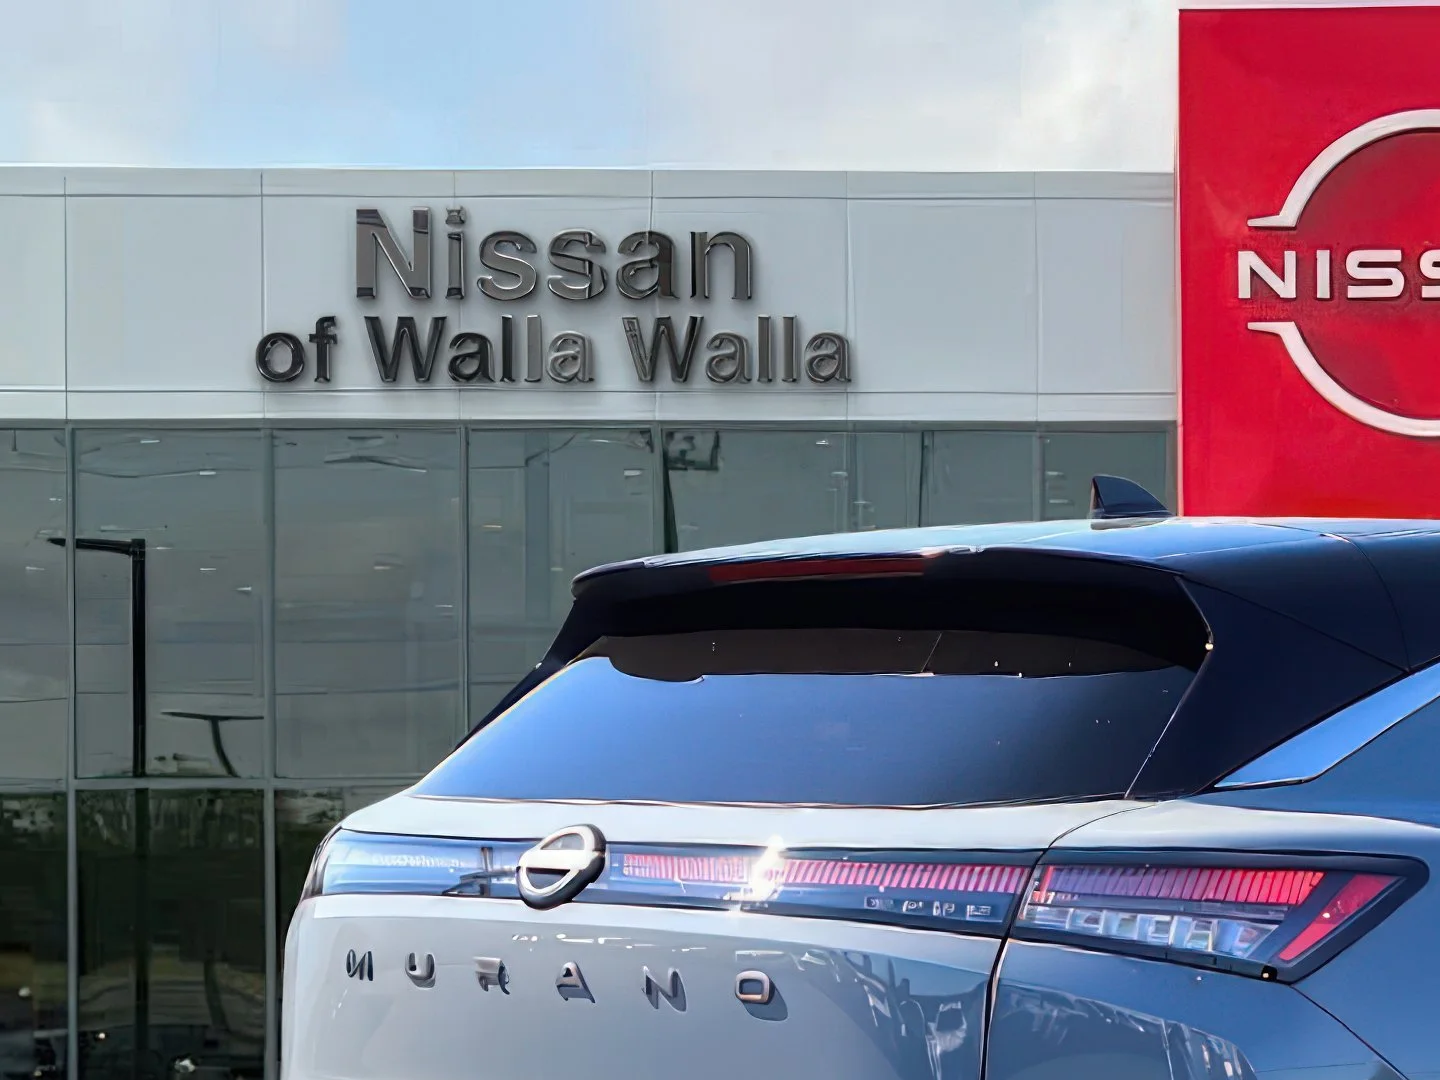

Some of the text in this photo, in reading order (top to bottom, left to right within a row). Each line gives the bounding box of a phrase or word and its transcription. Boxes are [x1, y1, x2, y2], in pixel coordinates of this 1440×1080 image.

[356, 205, 754, 300] Nissan
[255, 314, 852, 384] of Walla Walla
[346, 948, 776, 1012] MURANO
